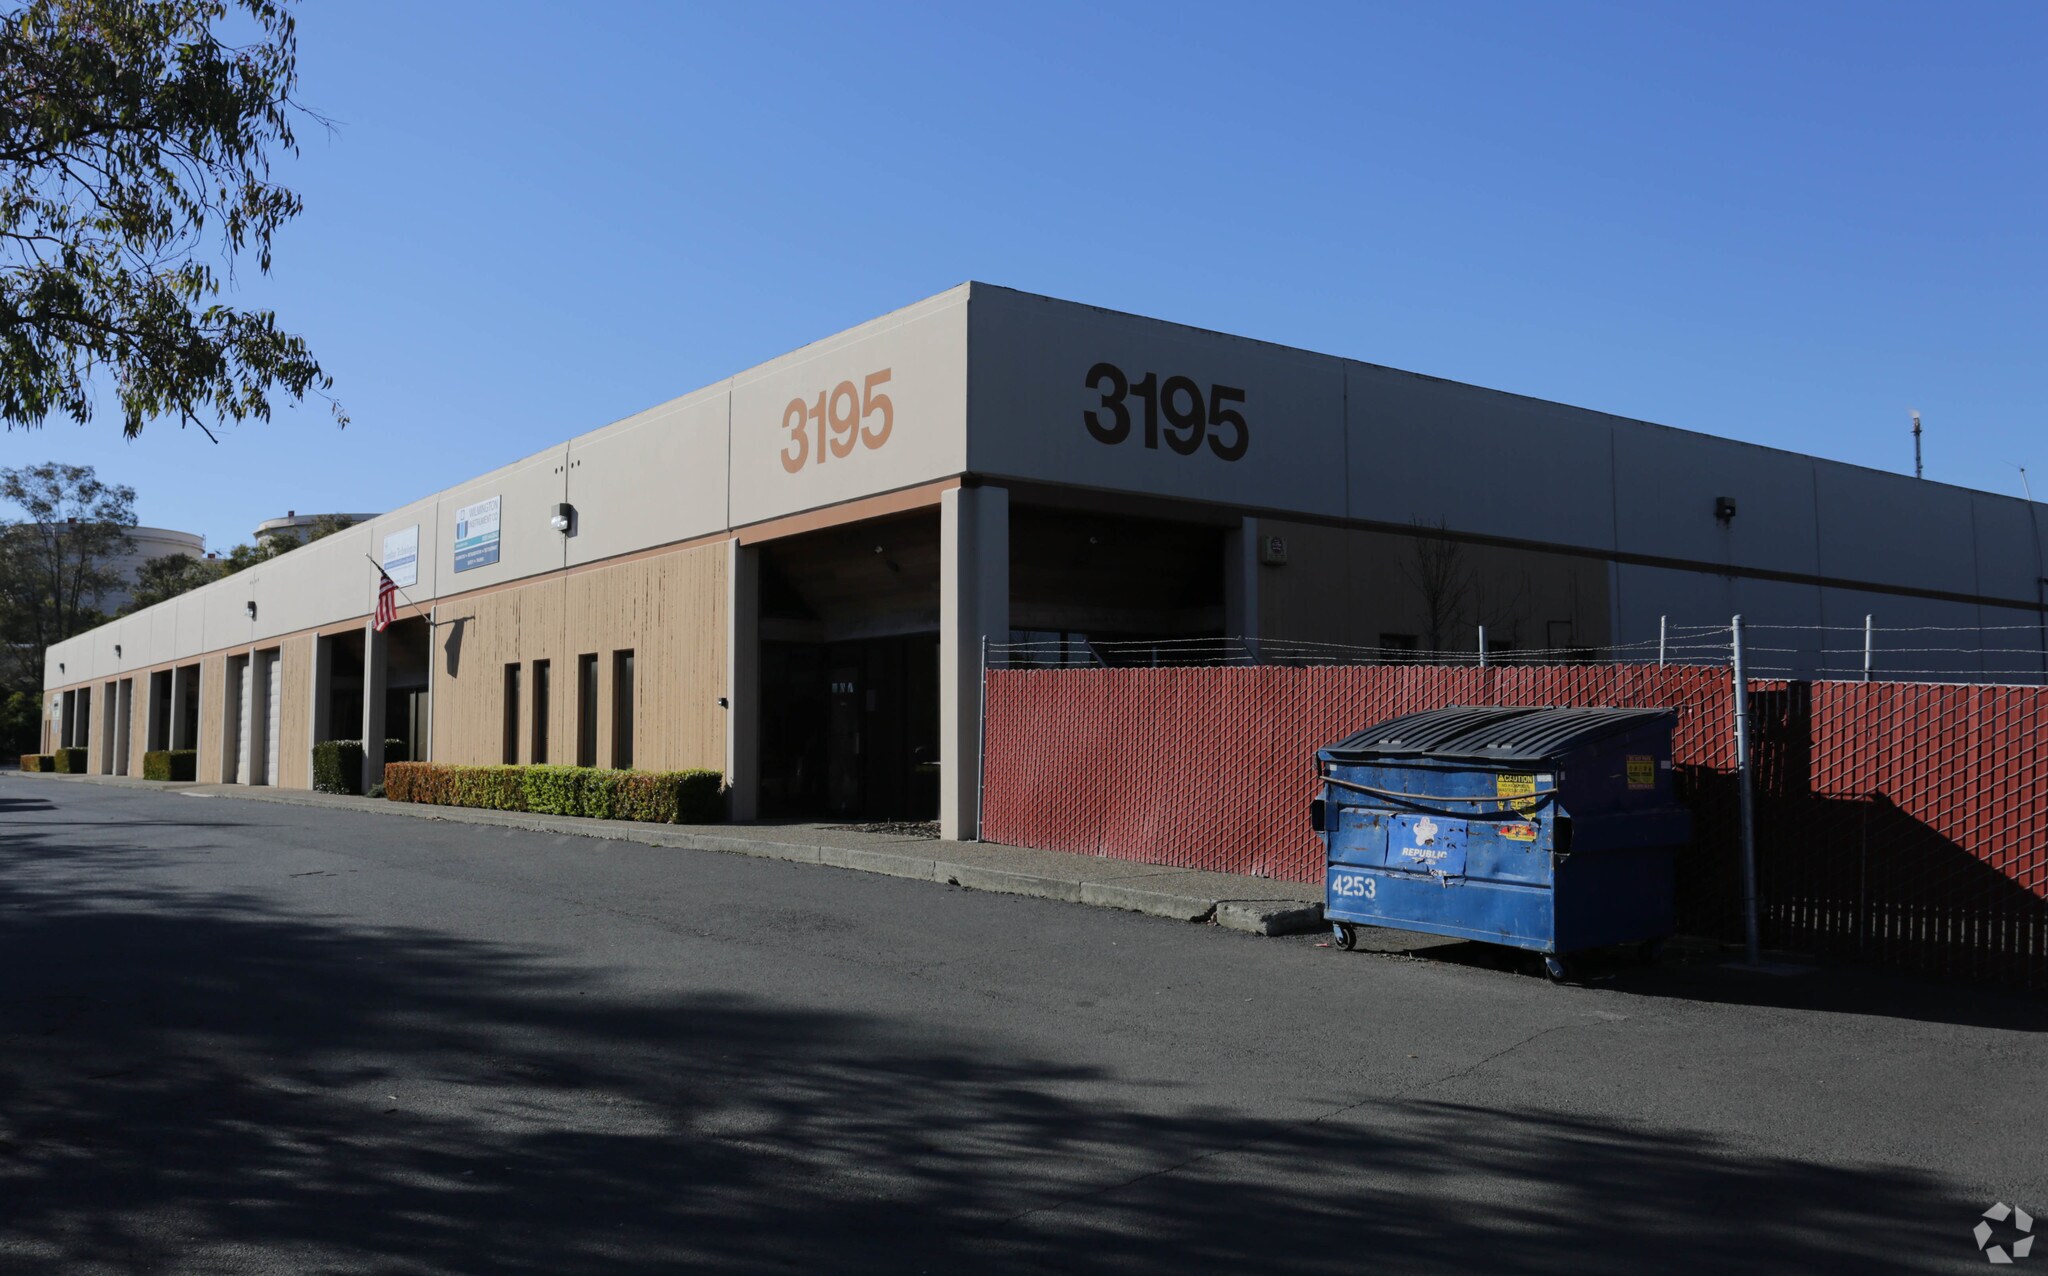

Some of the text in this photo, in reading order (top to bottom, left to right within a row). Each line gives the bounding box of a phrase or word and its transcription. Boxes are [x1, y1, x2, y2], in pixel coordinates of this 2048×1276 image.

[780, 367, 894, 474] 3195
[1083, 362, 1250, 462] 3195
[468, 500, 498, 518] WILMINGTON
[1504, 774, 1533, 783] CAUTION
[1402, 847, 1448, 859] REPUBLIC
[1332, 874, 1376, 899] 4253
